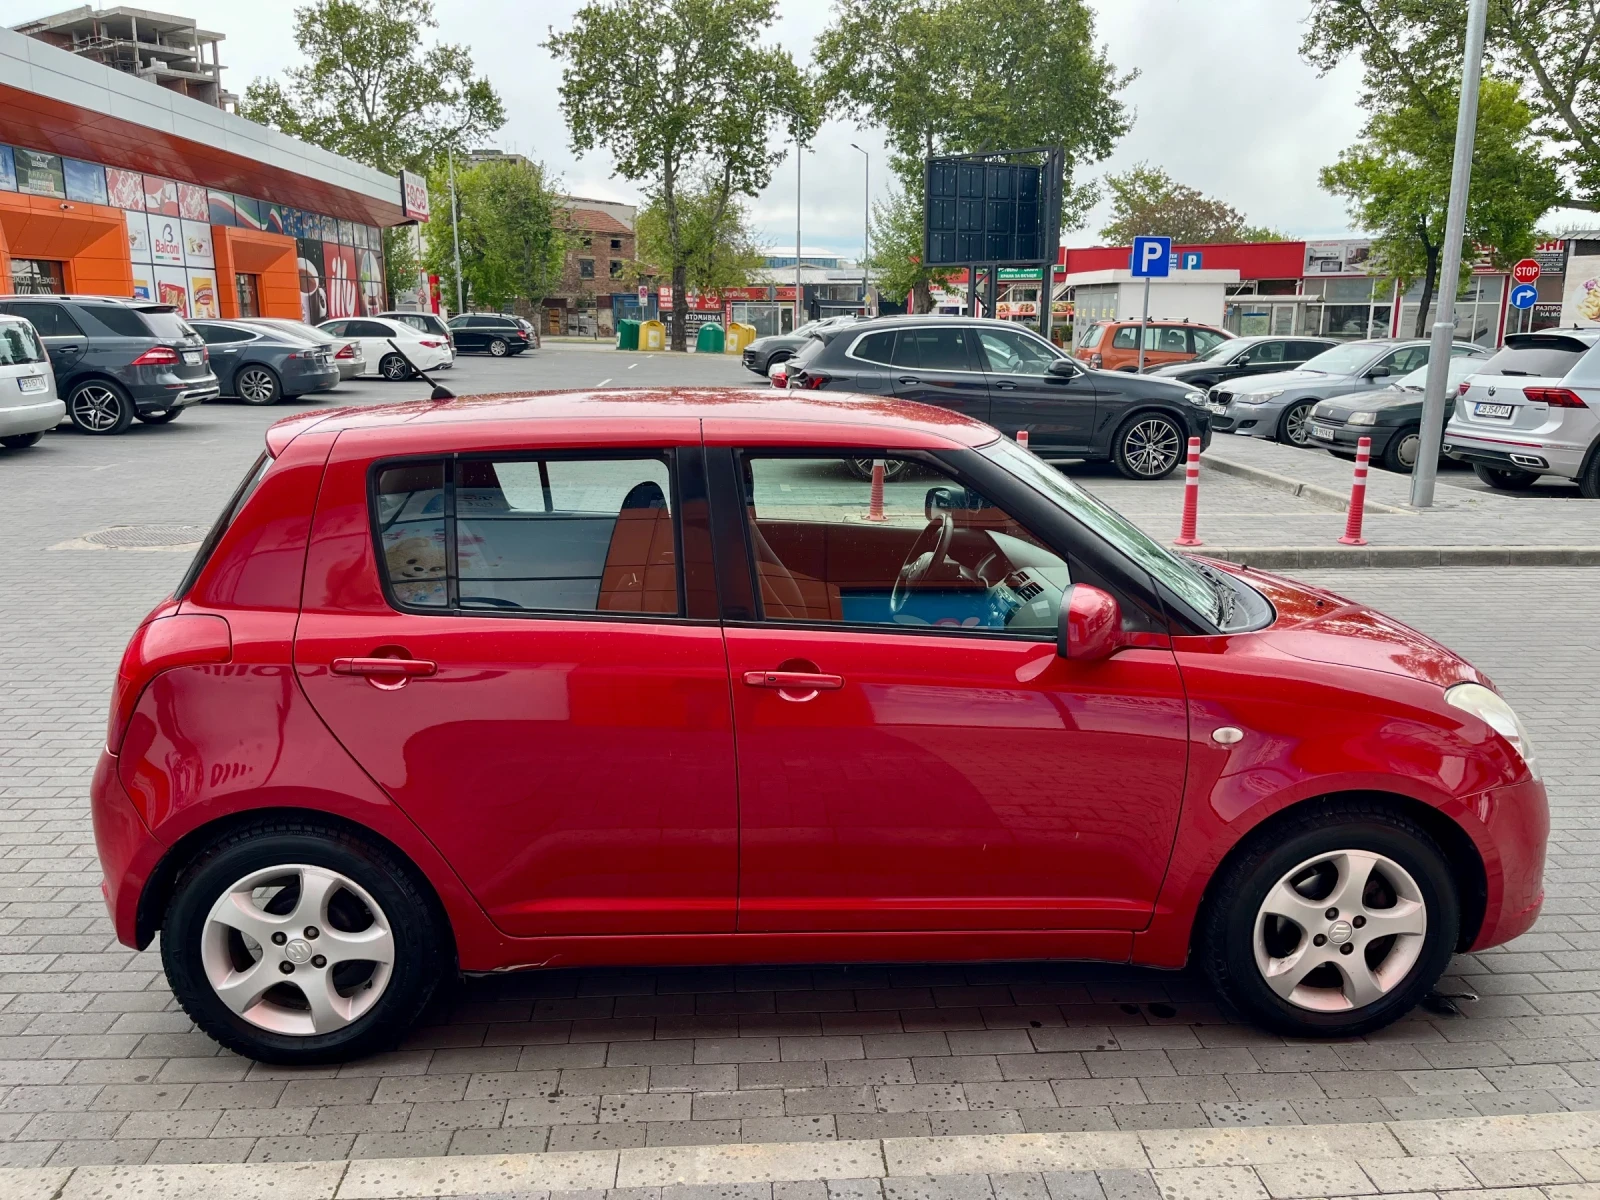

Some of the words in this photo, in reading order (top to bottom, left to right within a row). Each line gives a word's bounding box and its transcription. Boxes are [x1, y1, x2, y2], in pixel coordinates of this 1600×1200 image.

[155, 239, 180, 255] Balconi
[1141, 242, 1162, 272] P
[1187, 255, 1197, 270] P
[1516, 267, 1538, 276] STOP
[331, 256, 355, 318] illy
